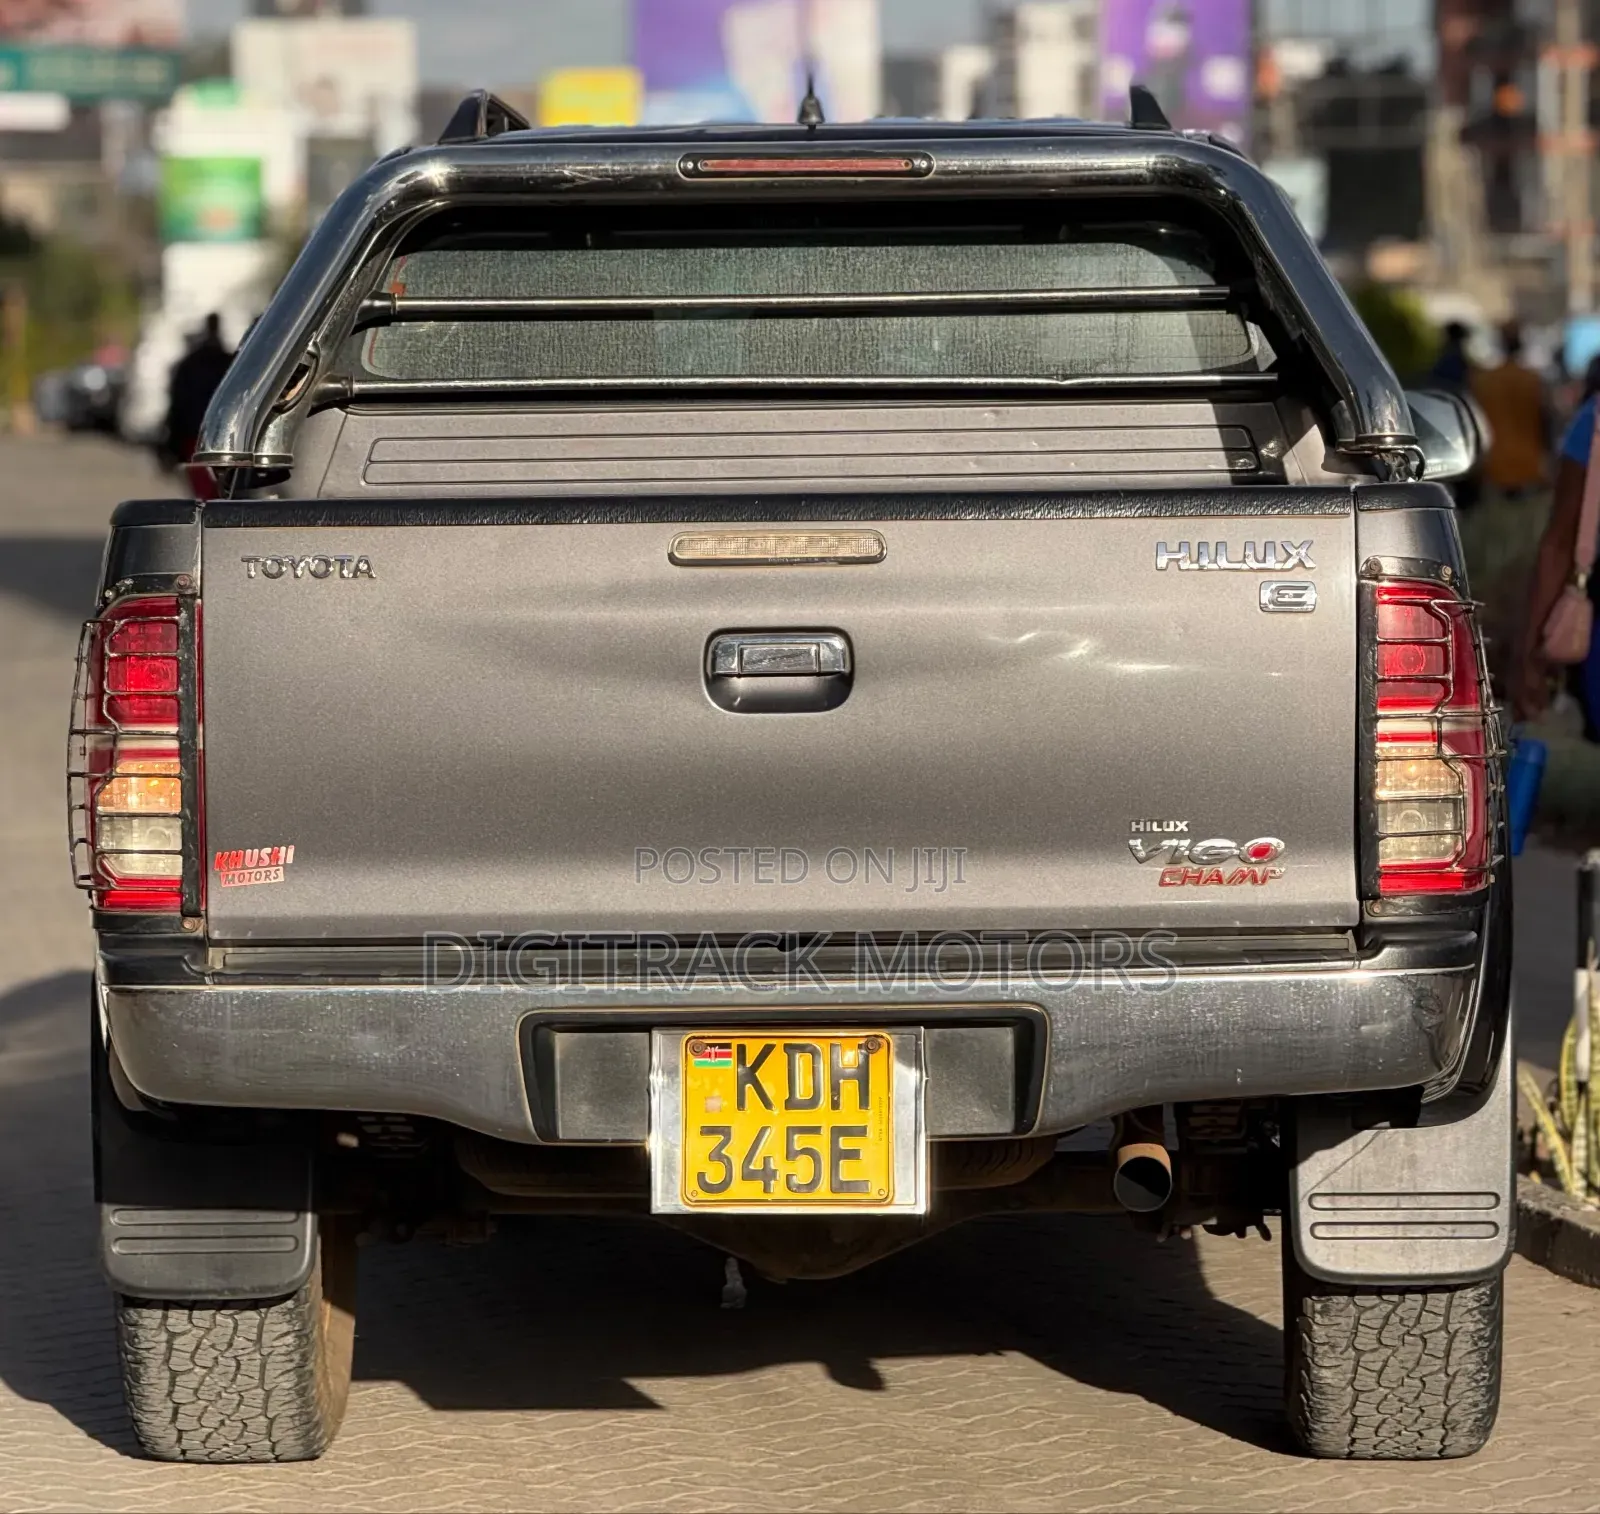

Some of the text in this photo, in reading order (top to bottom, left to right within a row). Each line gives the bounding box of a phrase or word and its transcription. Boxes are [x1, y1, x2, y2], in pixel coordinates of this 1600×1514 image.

[240, 554, 377, 580] TOYOTA
[1155, 540, 1317, 571] HILUX
[1130, 820, 1190, 832] HILUX
[214, 844, 295, 871] KHUSHI
[1128, 837, 1286, 865] VIGO
[224, 868, 281, 885] MOTORS
[1158, 866, 1286, 887] CHAMP
[737, 1042, 871, 1112] KDH
[696, 1125, 872, 1194] 345E
